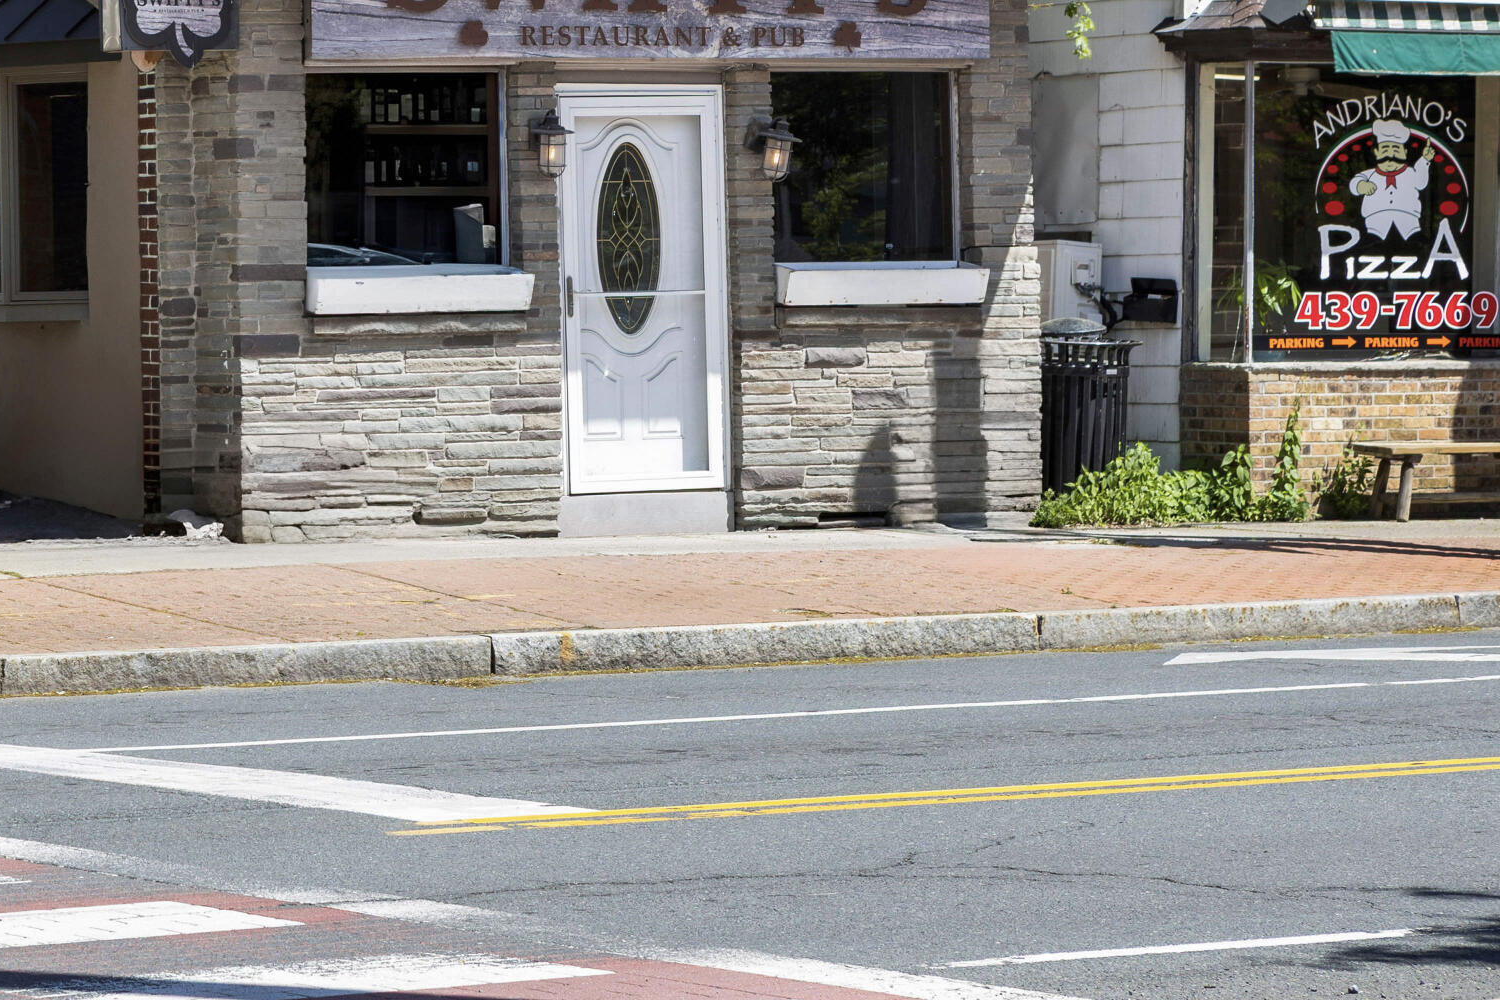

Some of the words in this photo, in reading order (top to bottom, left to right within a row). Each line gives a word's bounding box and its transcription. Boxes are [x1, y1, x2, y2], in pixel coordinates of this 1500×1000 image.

[520, 25, 711, 47] RESTAURANT
[722, 26, 741, 47] &
[753, 26, 805, 48] PUB
[1313, 92, 1467, 149] ANDRIANO'S
[1294, 291, 1498, 330] 439-7669
[1269, 337, 1324, 349] PARKING
[1364, 336, 1419, 348] PARKING
